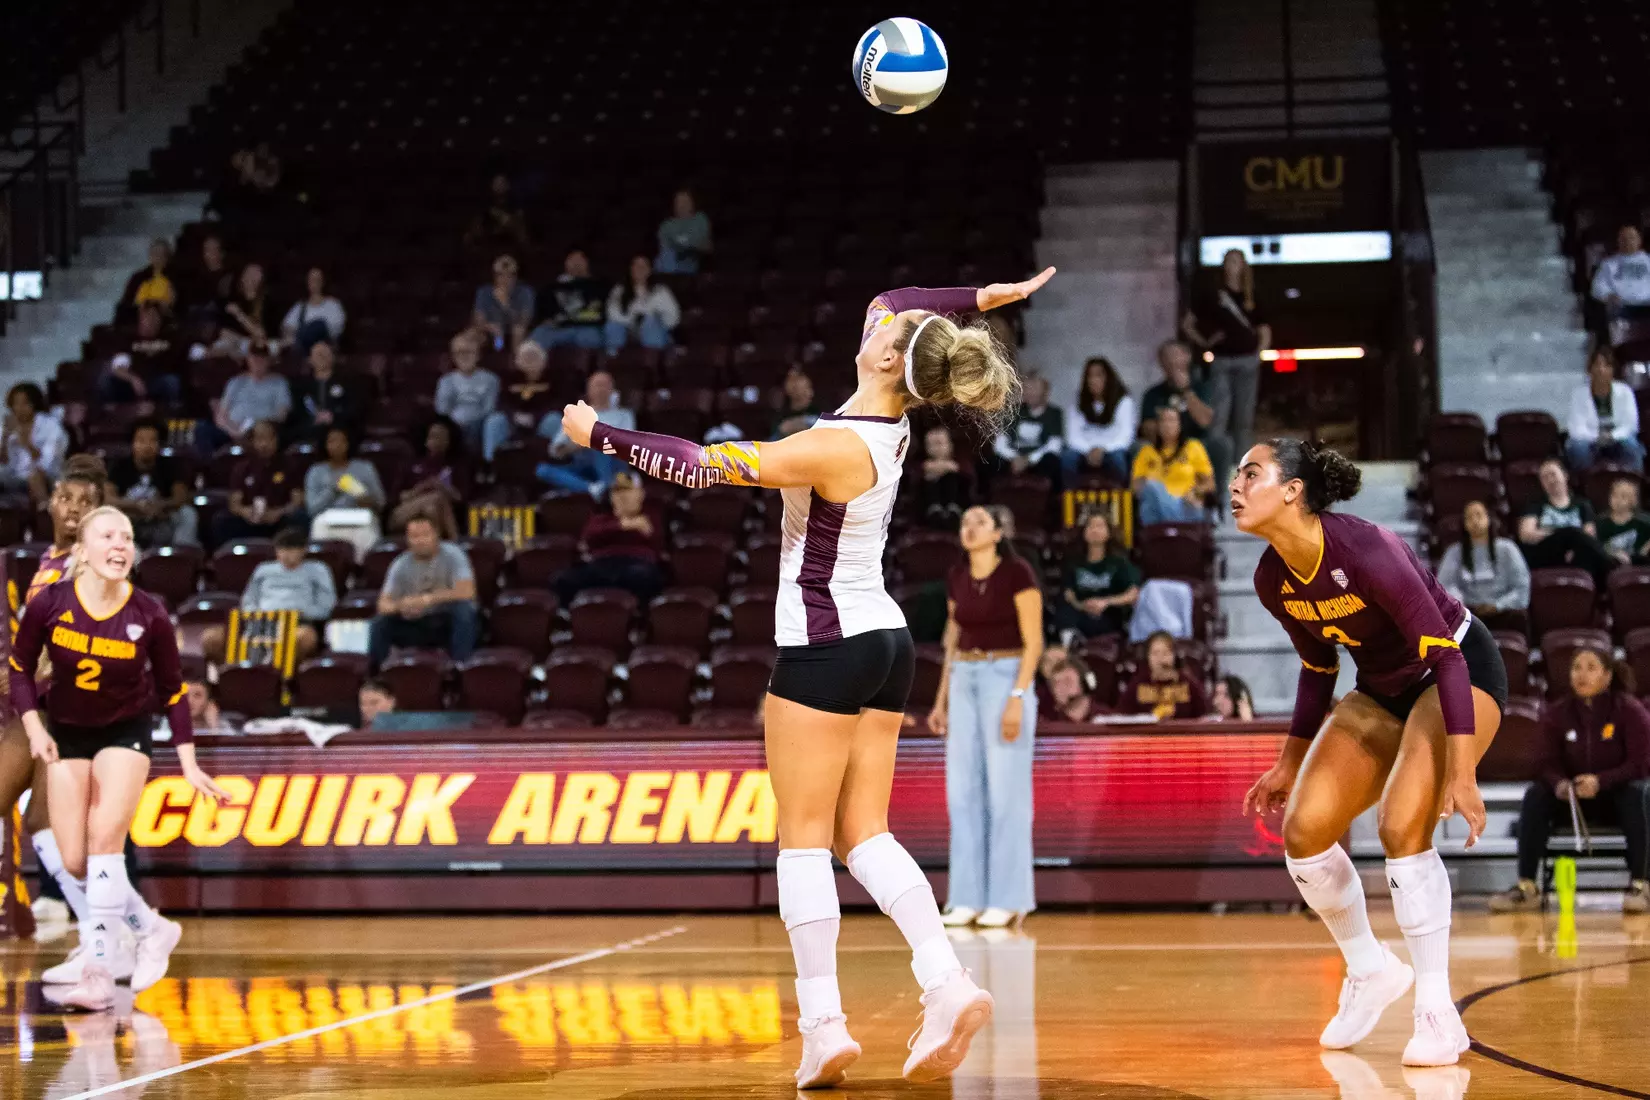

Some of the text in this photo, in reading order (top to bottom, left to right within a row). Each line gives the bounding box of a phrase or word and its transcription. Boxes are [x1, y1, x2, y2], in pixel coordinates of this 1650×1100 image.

[862, 47, 878, 98] molten
[1243, 156, 1345, 191] CMU
[629, 444, 722, 489] CHIPPEWAS
[1315, 593, 1367, 621] MICHIGAN
[75, 658, 102, 692] 2
[487, 769, 779, 845] ARENA
